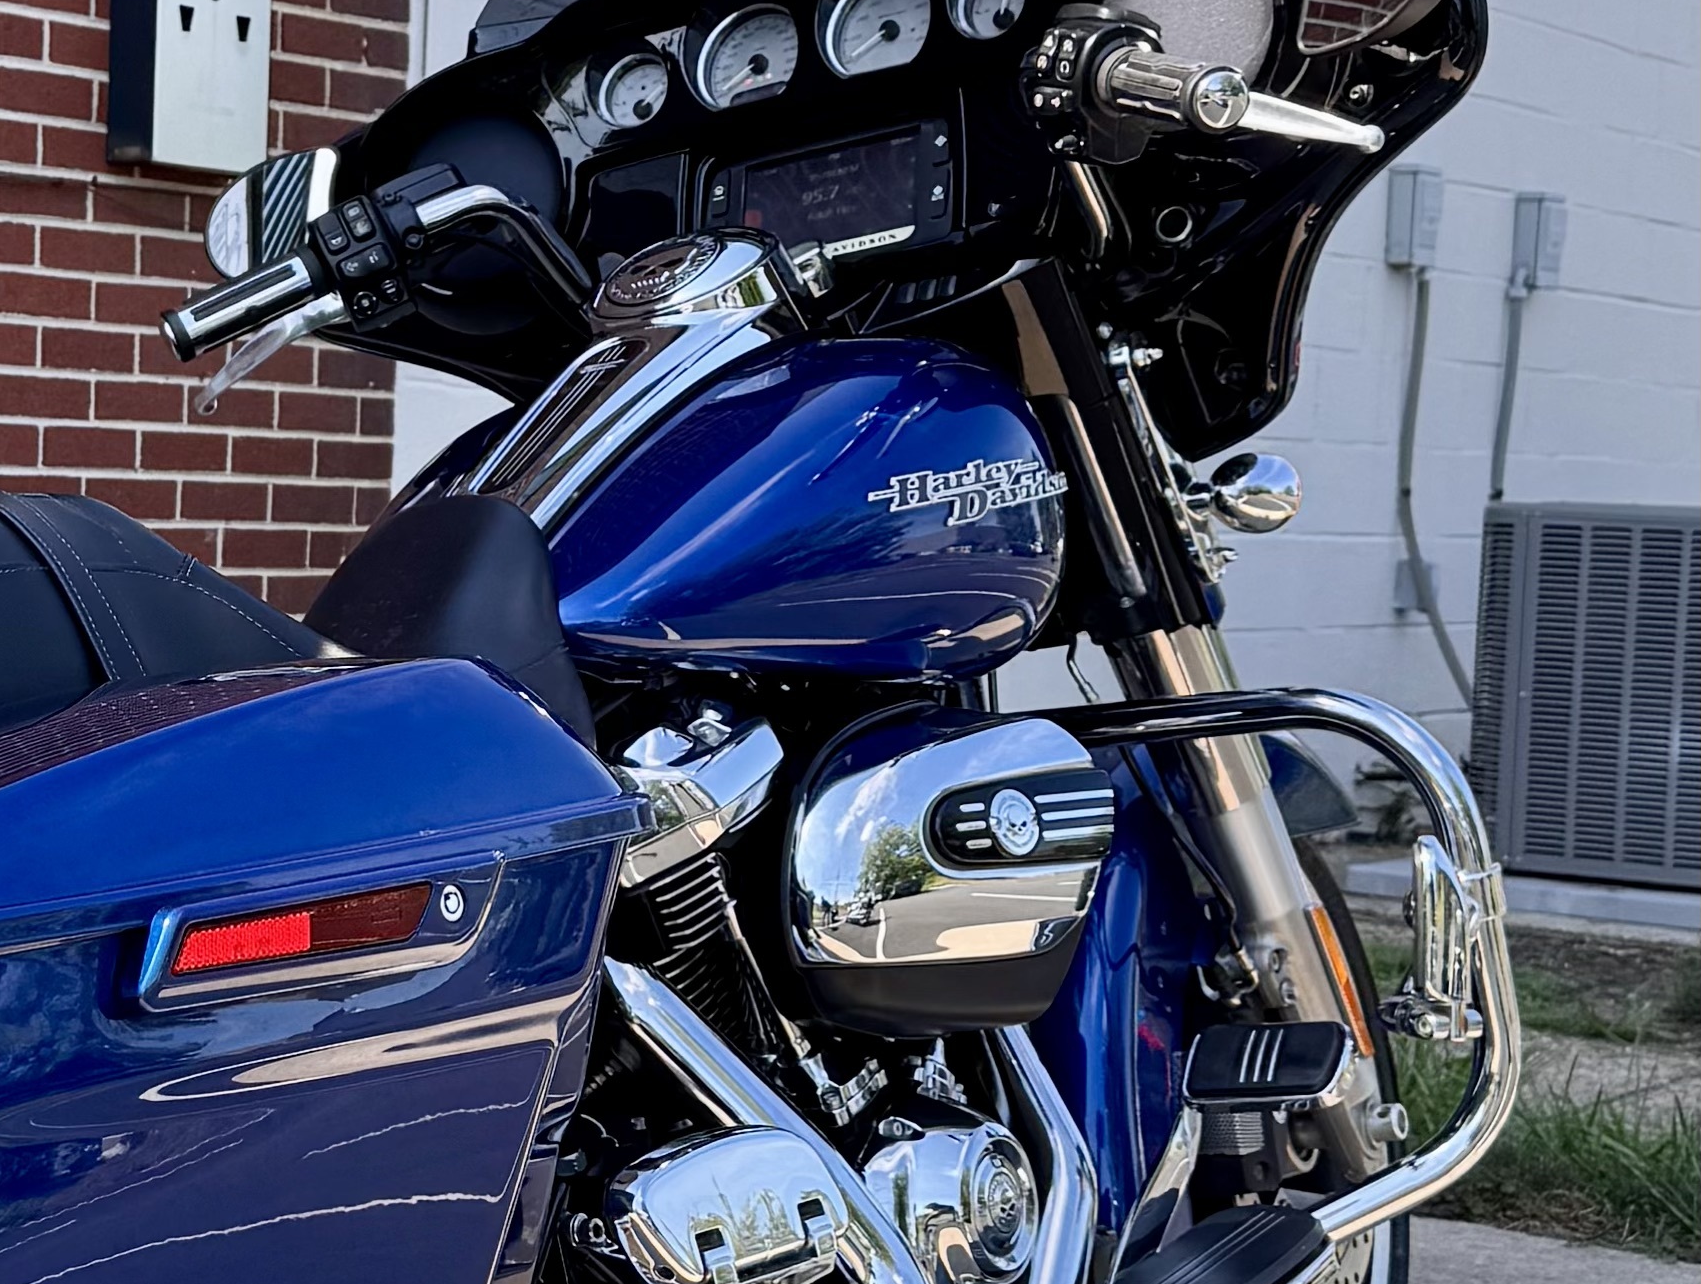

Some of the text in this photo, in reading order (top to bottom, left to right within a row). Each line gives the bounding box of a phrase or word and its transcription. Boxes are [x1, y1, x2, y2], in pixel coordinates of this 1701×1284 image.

[801, 184, 840, 206] 95.7
[832, 232, 898, 253] AVIDSON
[889, 458, 1024, 513] Harley
